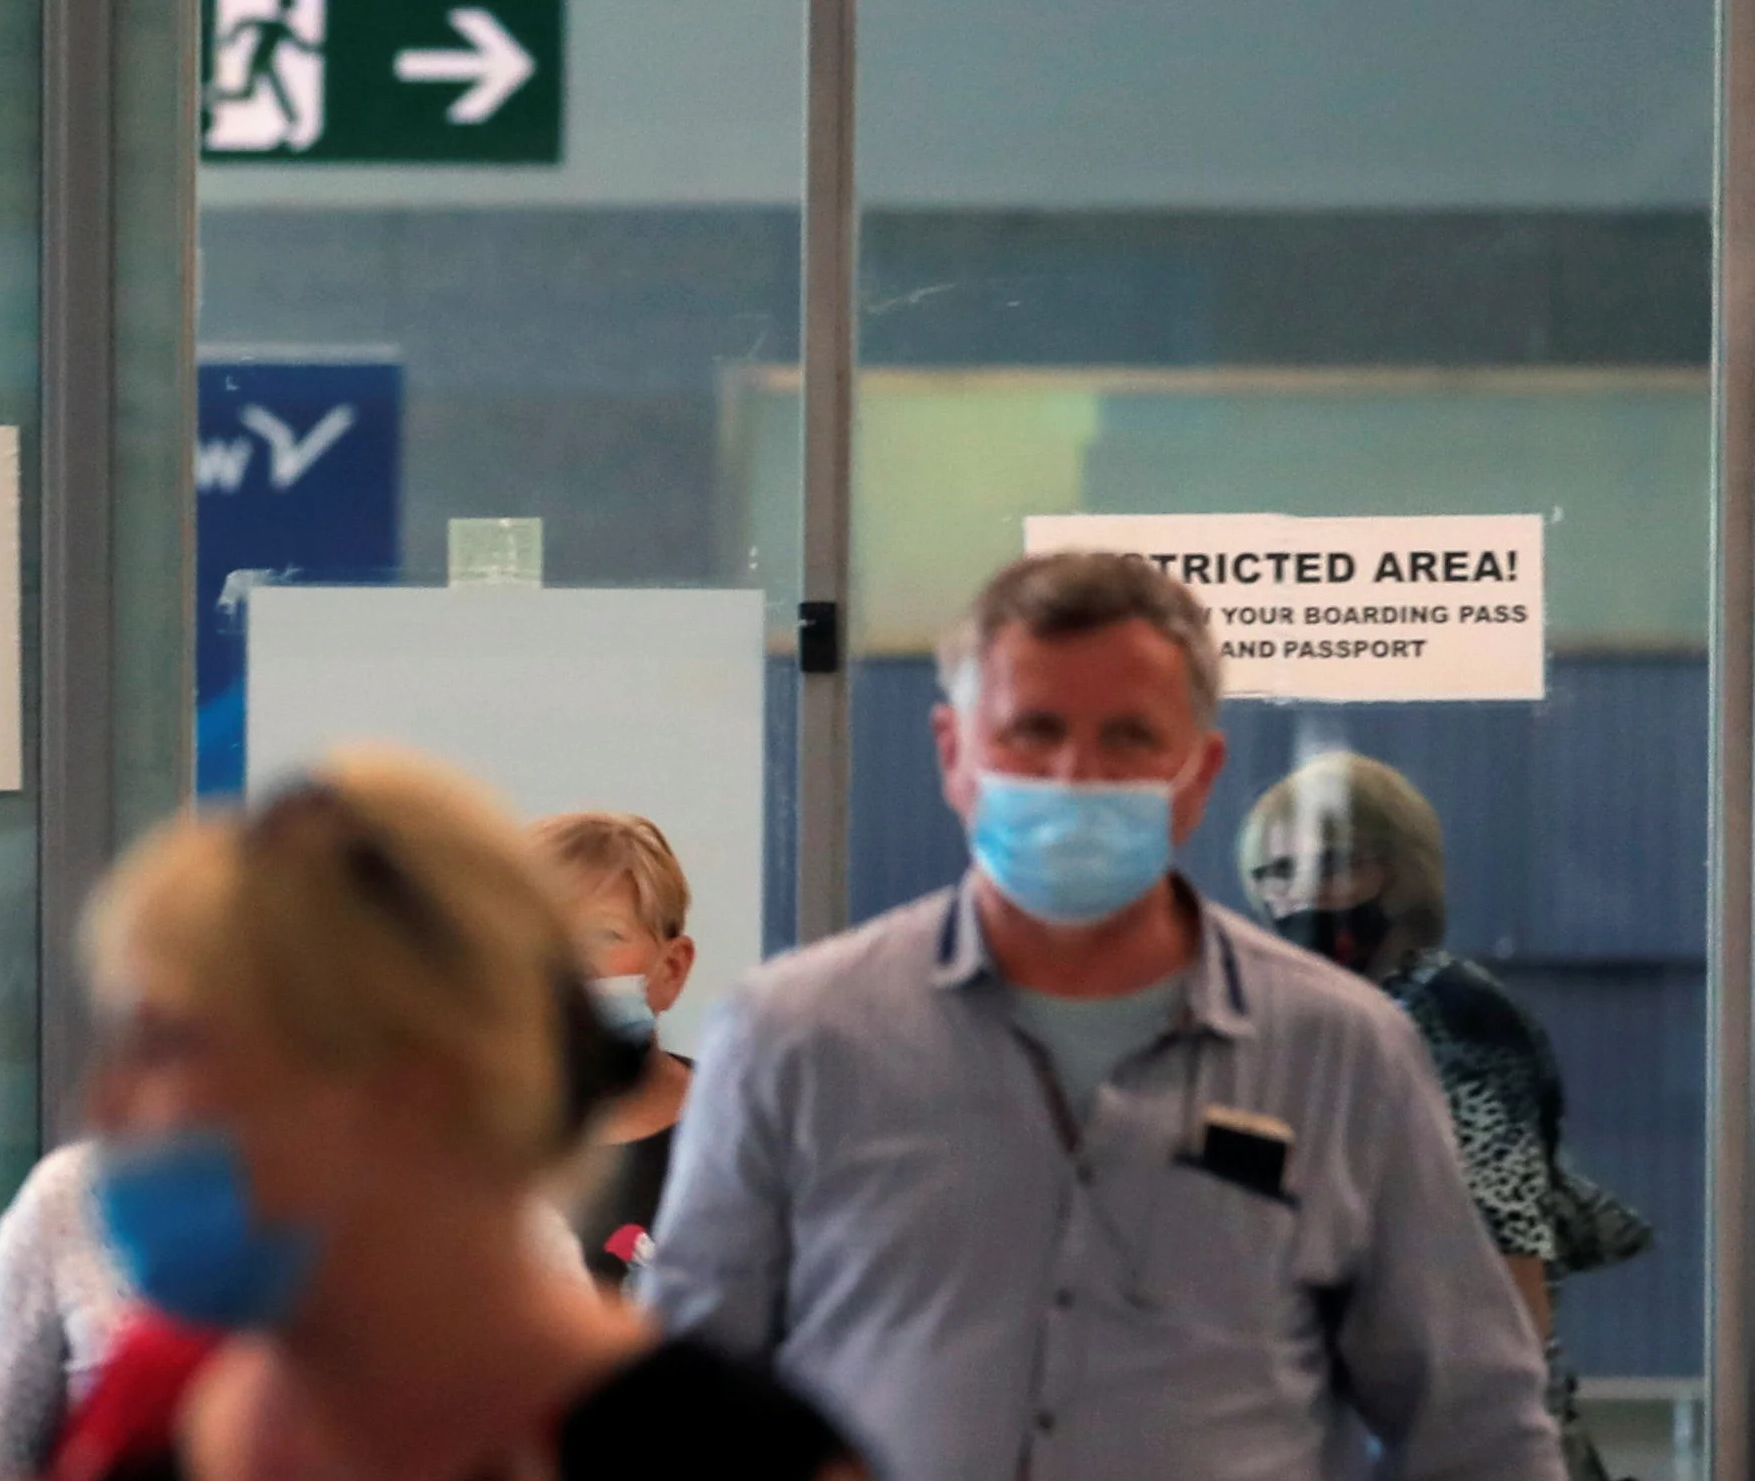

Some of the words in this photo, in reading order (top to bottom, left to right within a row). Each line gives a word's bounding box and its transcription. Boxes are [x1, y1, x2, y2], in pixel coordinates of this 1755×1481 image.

[1122, 552, 1355, 583] TRICTED
[1373, 550, 1518, 583] AREA!
[1222, 606, 1294, 625] YOUR
[1303, 605, 1449, 625] BOARDING
[1458, 604, 1528, 623] PASS
[1220, 641, 1276, 658] AND
[1283, 640, 1428, 658] PASSPORT
